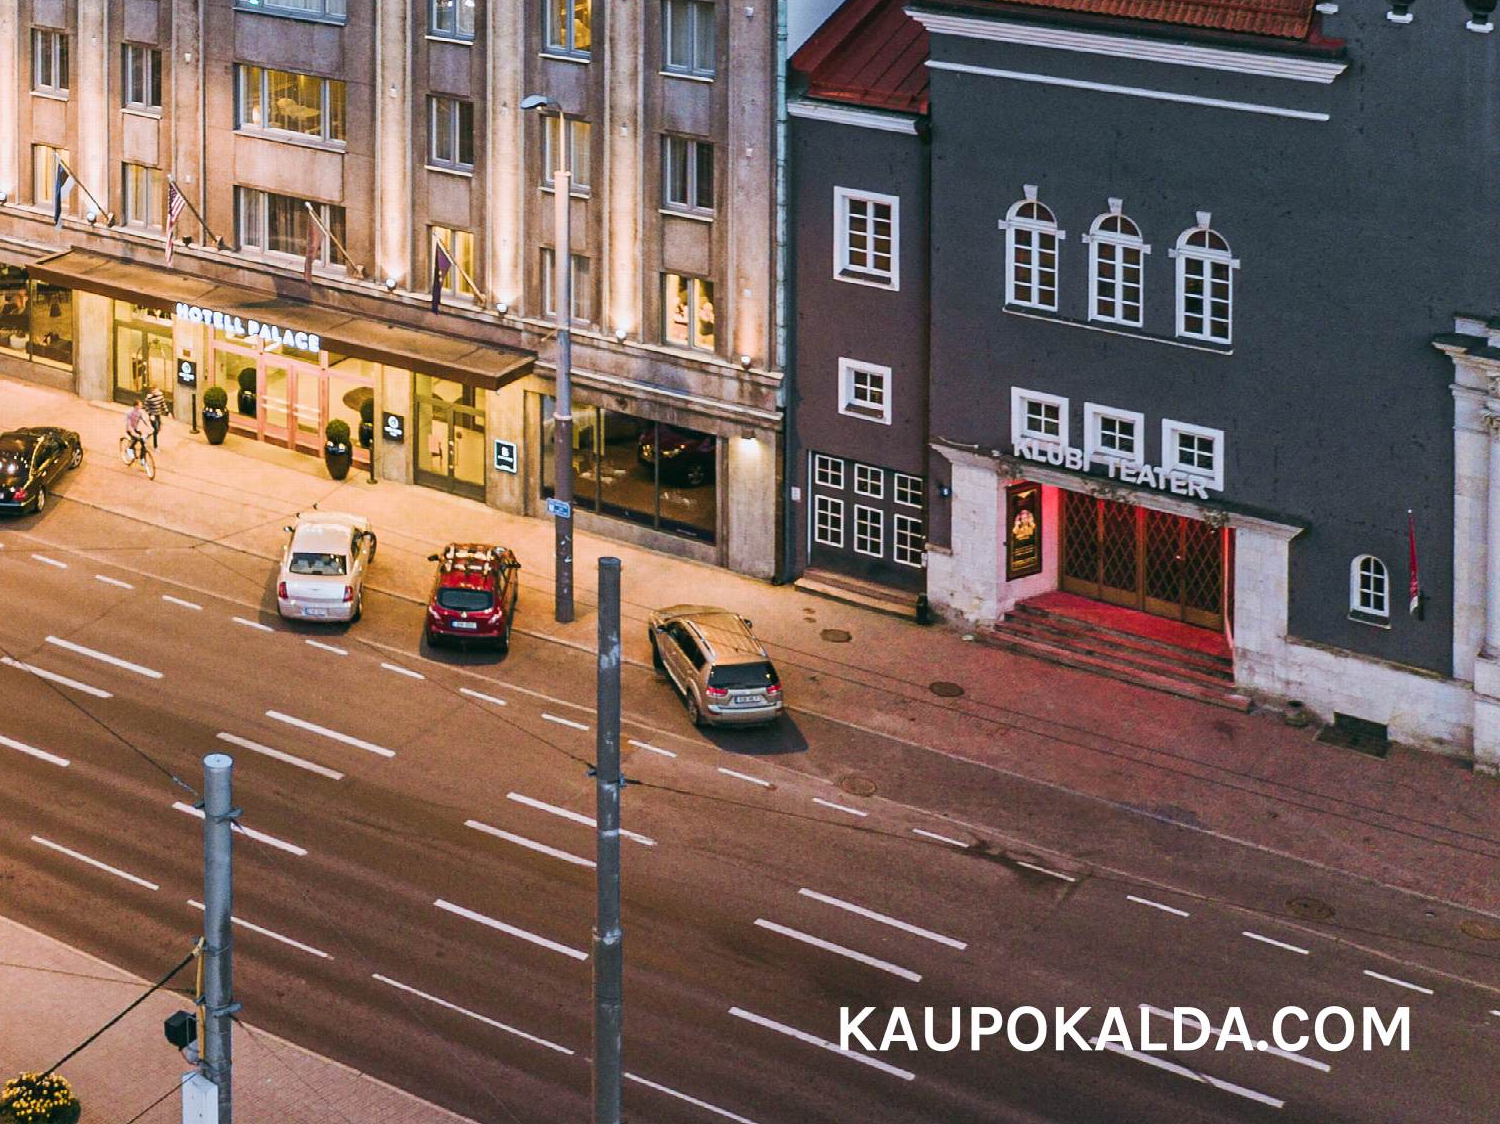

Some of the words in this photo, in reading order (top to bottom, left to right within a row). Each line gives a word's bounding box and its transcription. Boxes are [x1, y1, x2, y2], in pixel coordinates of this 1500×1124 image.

[176, 302, 244, 334] HOTELL
[248, 319, 320, 352] PALACE
[1012, 440, 1091, 473] KLUBI
[1106, 457, 1208, 499] TEATER
